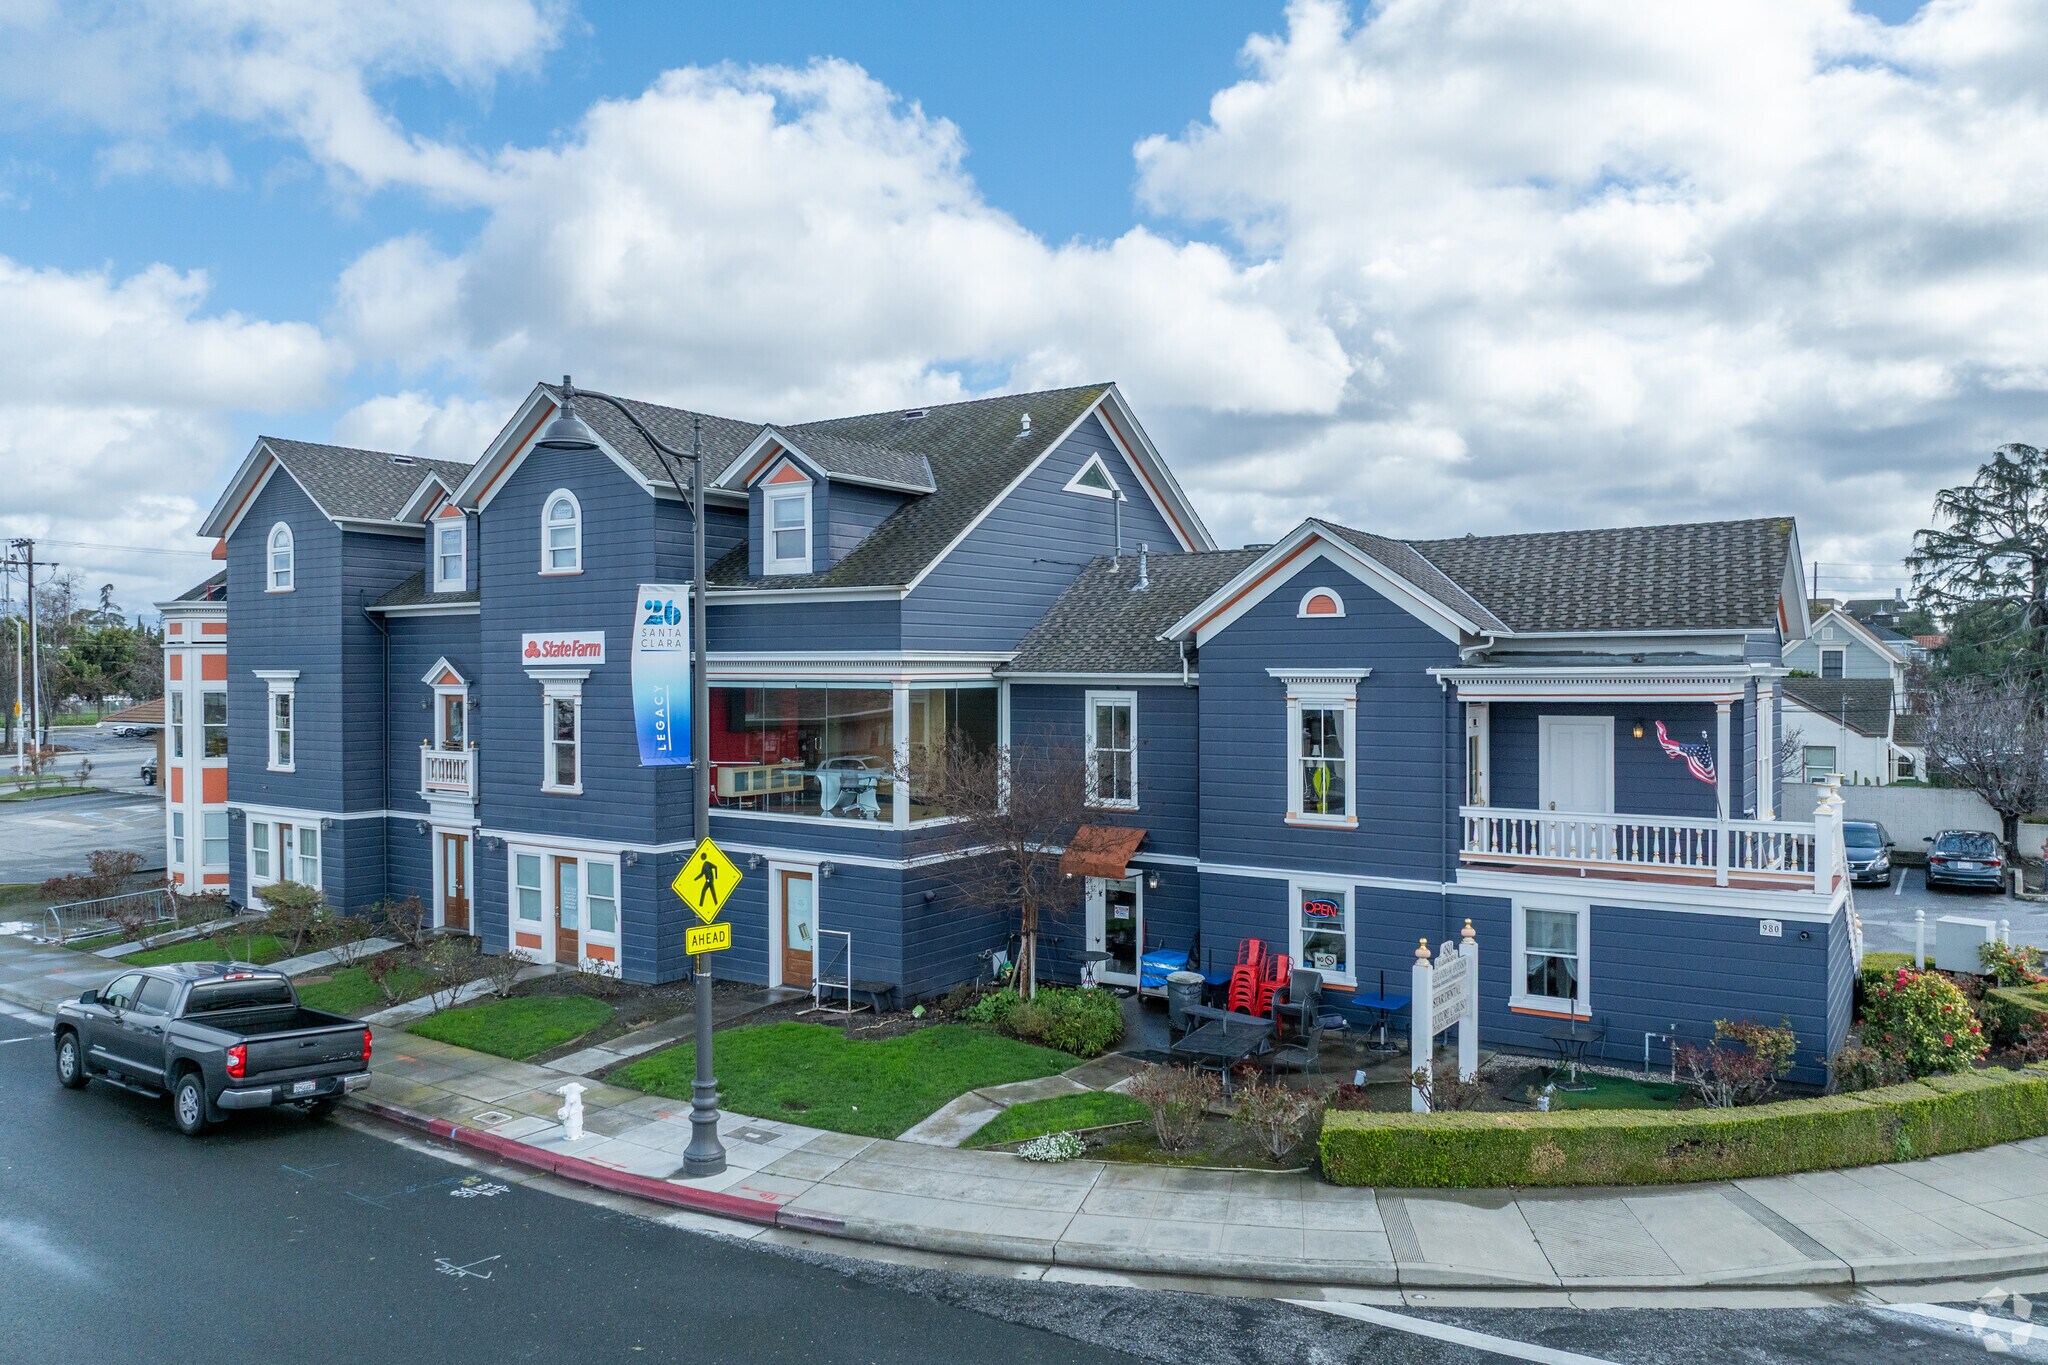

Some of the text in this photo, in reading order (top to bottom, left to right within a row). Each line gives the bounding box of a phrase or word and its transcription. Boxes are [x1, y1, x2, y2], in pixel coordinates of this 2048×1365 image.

[643, 599, 682, 626] 26
[641, 628, 682, 637] SANTA
[641, 638, 682, 648] CLARA
[654, 685, 667, 751] LEGACY
[1303, 901, 1338, 918] OPEN
[1762, 924, 1779, 933] 980
[691, 930, 726, 947] AHEAD
